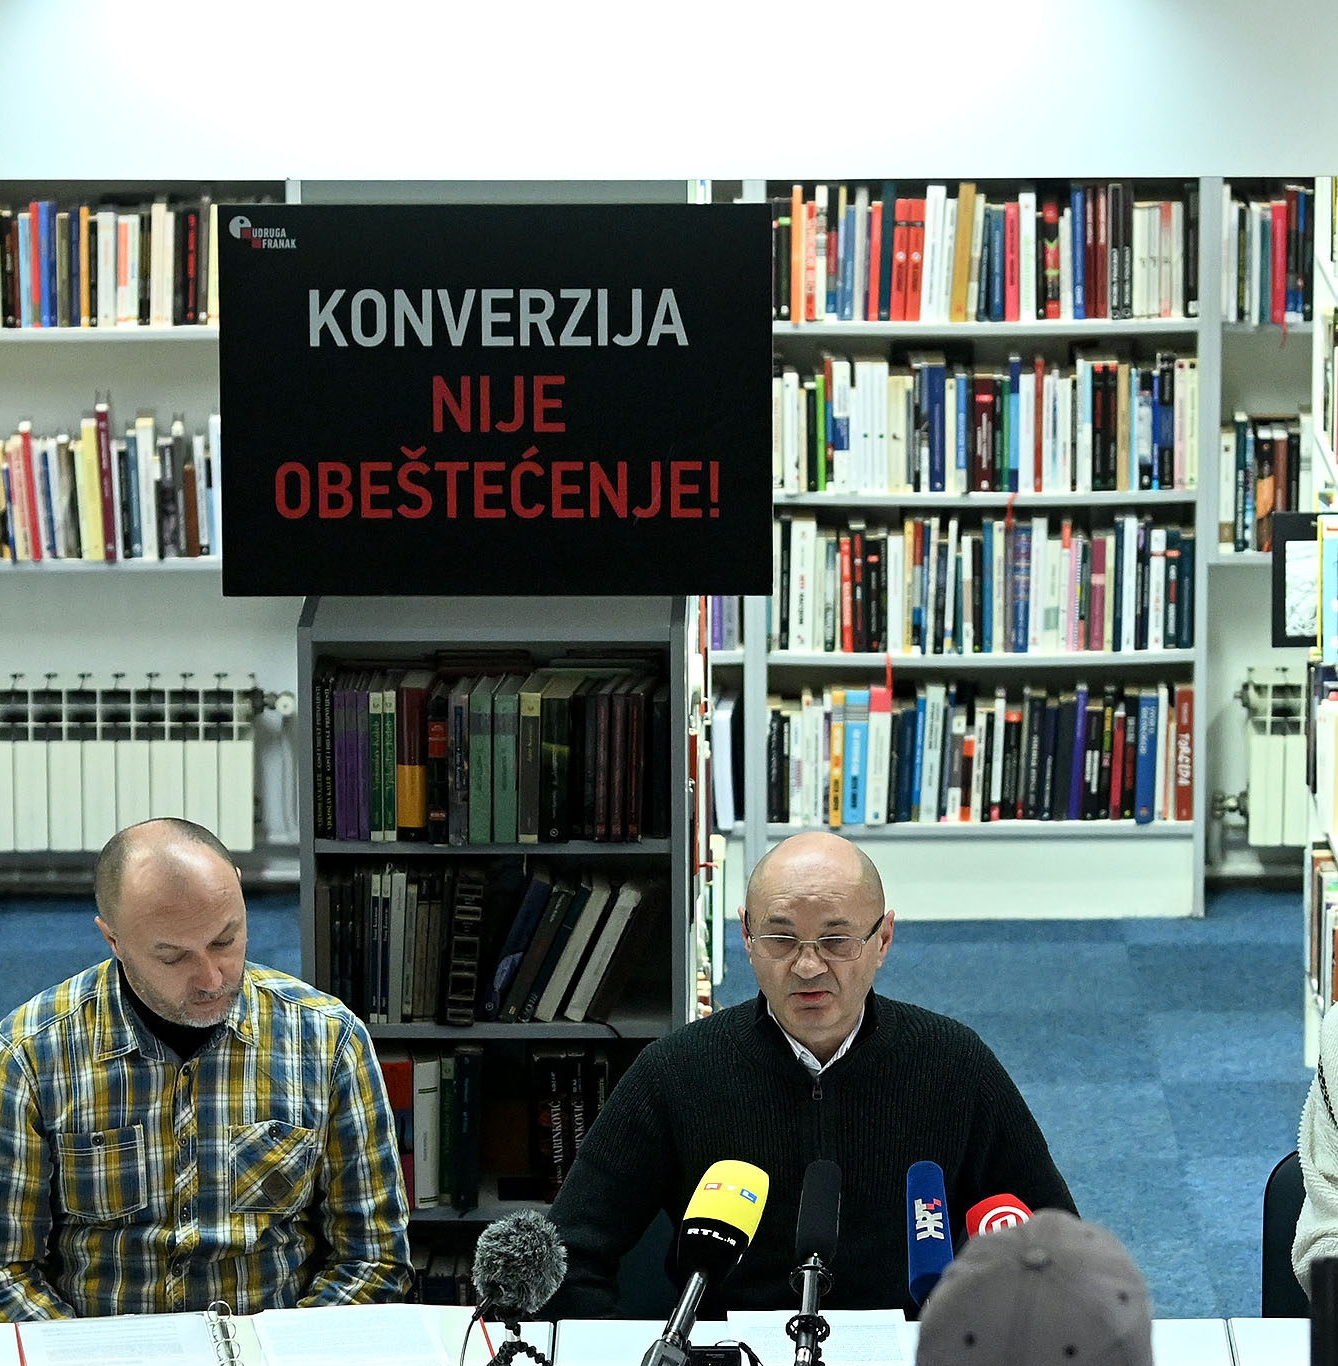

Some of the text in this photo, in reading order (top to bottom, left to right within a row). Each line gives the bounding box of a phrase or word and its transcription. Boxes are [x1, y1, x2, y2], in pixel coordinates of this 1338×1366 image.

[252, 227, 287, 238] UDRUGA
[262, 238, 297, 249] FRANAK
[308, 288, 689, 348] KONVERZIJA
[432, 374, 566, 434] NIJE
[274, 445, 721, 520] OBEŠTEĆENJE!
[550, 1100, 562, 1164] MARINKOVIĆ
[914, 1198, 945, 1241] HRT
